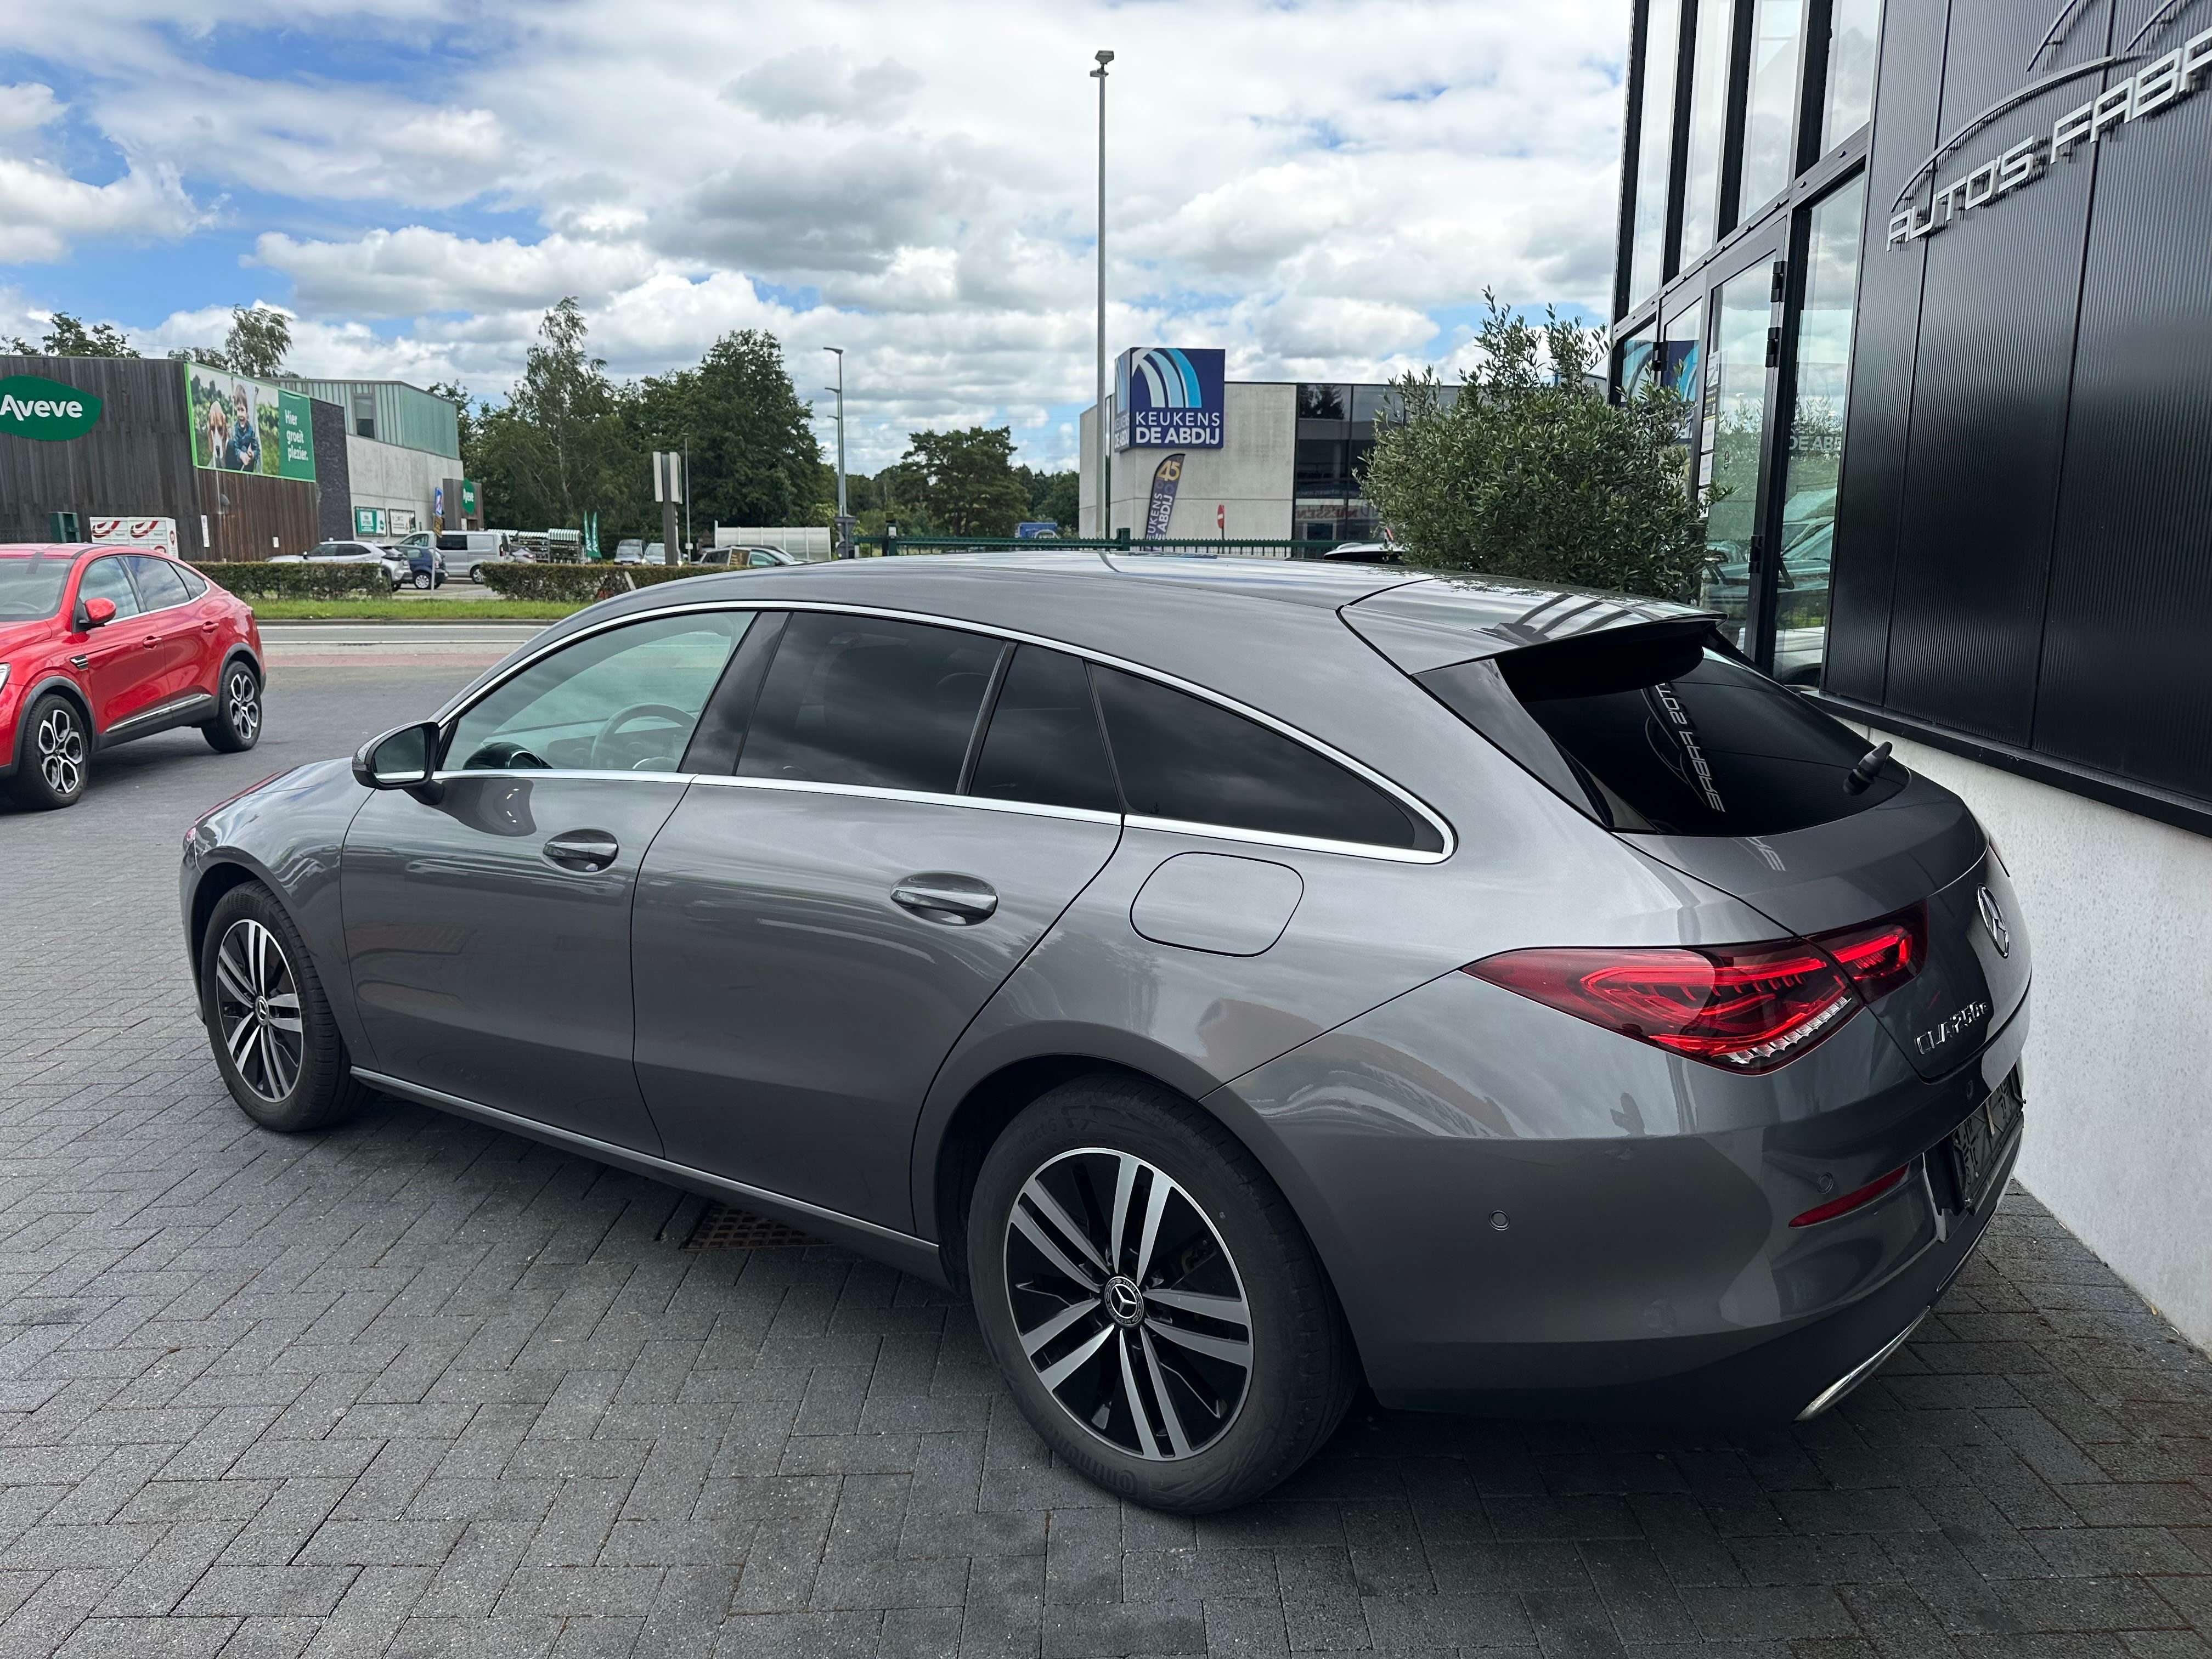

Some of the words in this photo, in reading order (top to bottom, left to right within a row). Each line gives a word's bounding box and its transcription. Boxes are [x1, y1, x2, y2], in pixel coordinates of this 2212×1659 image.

[1887, 136, 2034, 252] AUTO'S
[0, 394, 83, 421] Aveve
[285, 409, 297, 426] Hier
[1136, 411, 1220, 426] KEUKENS
[286, 429, 304, 445] groeit
[1136, 427, 1162, 444] DE
[1164, 427, 1220, 444] ABDIJ
[1158, 460, 1181, 482] 45
[1157, 494, 1173, 533] ABDIJ
